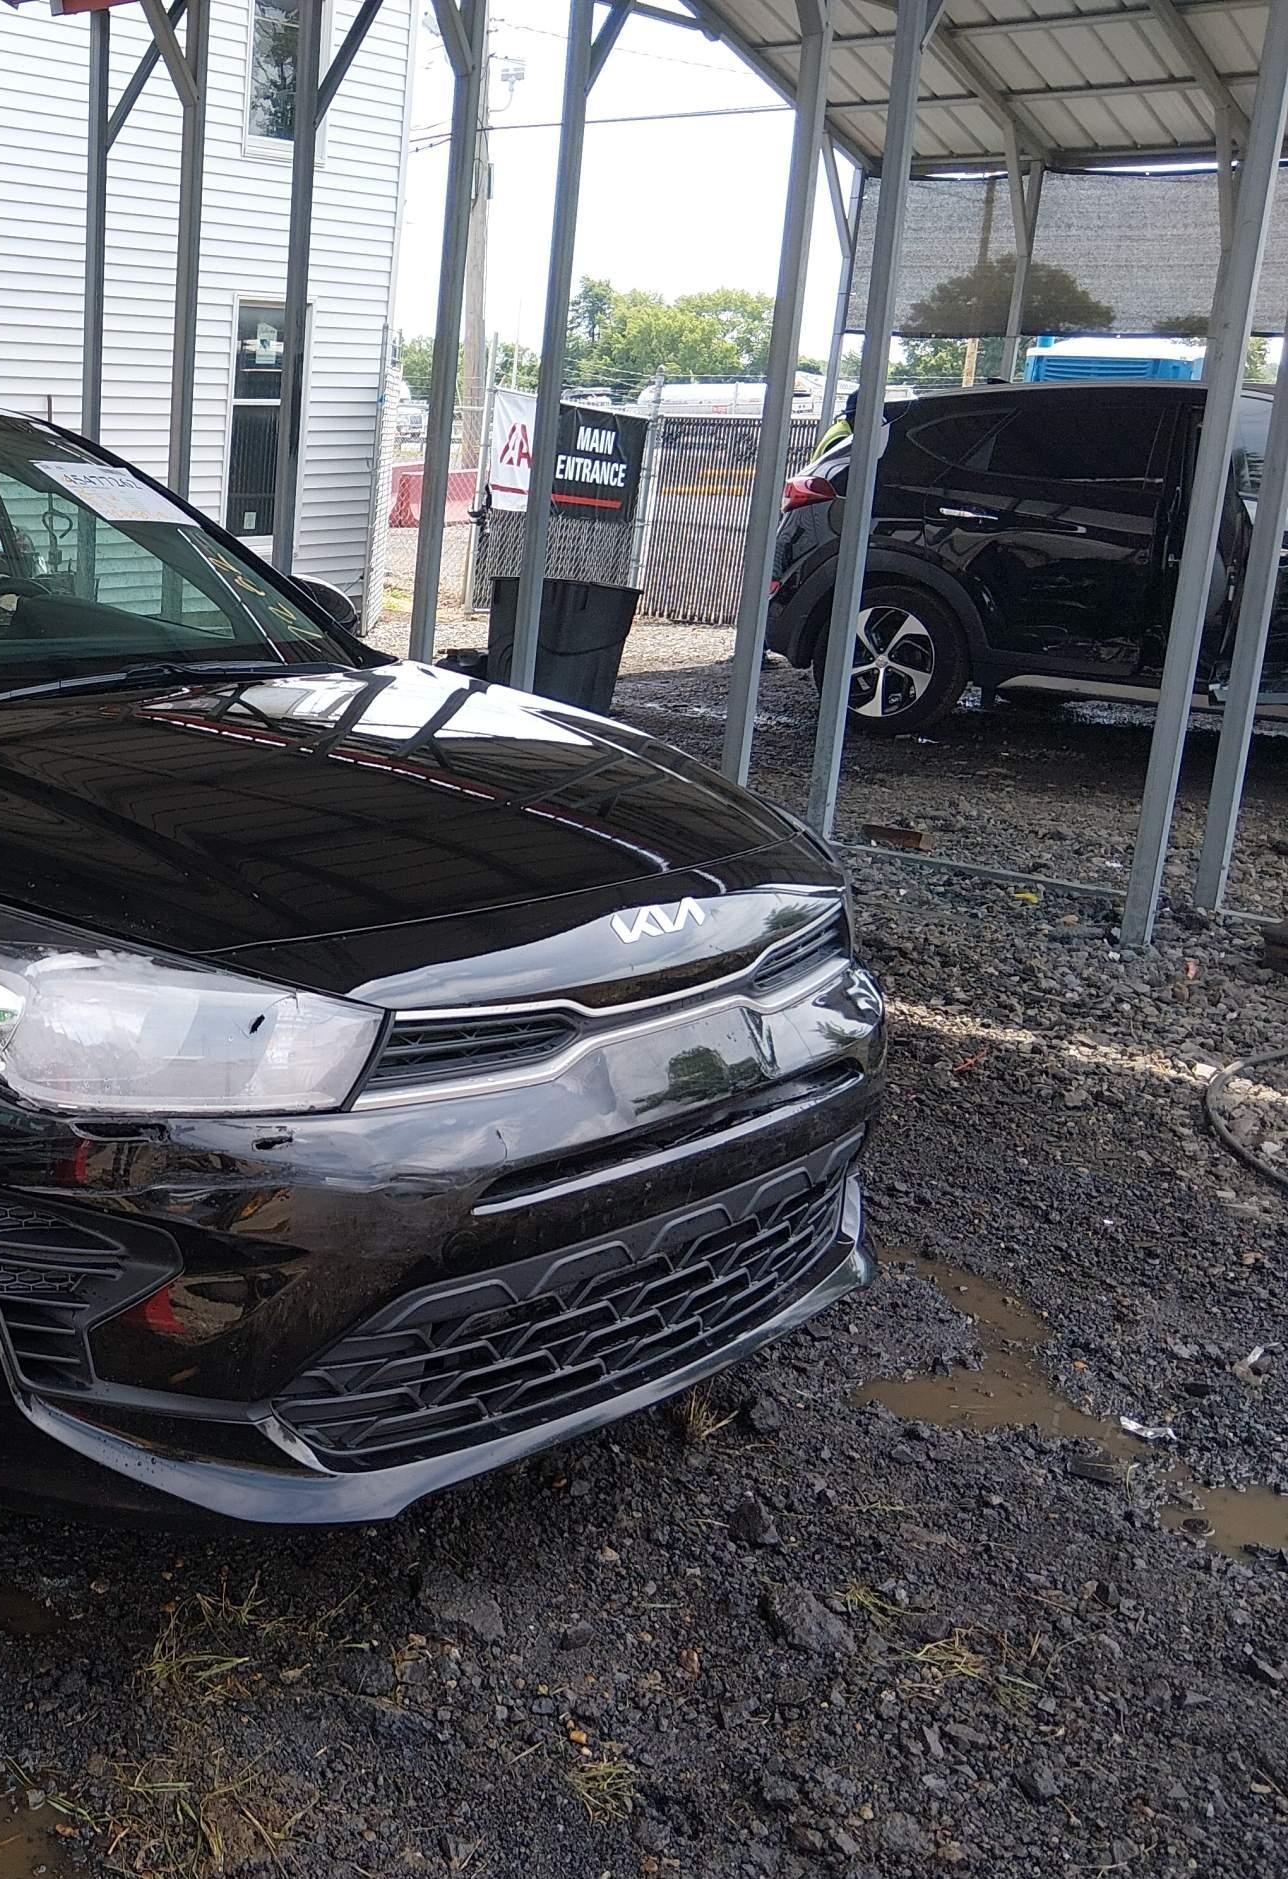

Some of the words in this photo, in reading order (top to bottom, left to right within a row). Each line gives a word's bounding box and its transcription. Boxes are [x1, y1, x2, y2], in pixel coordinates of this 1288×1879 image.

[576, 426, 616, 456] MAIN
[555, 454, 627, 488] ENTRANCE
[610, 897, 706, 944] KIA
